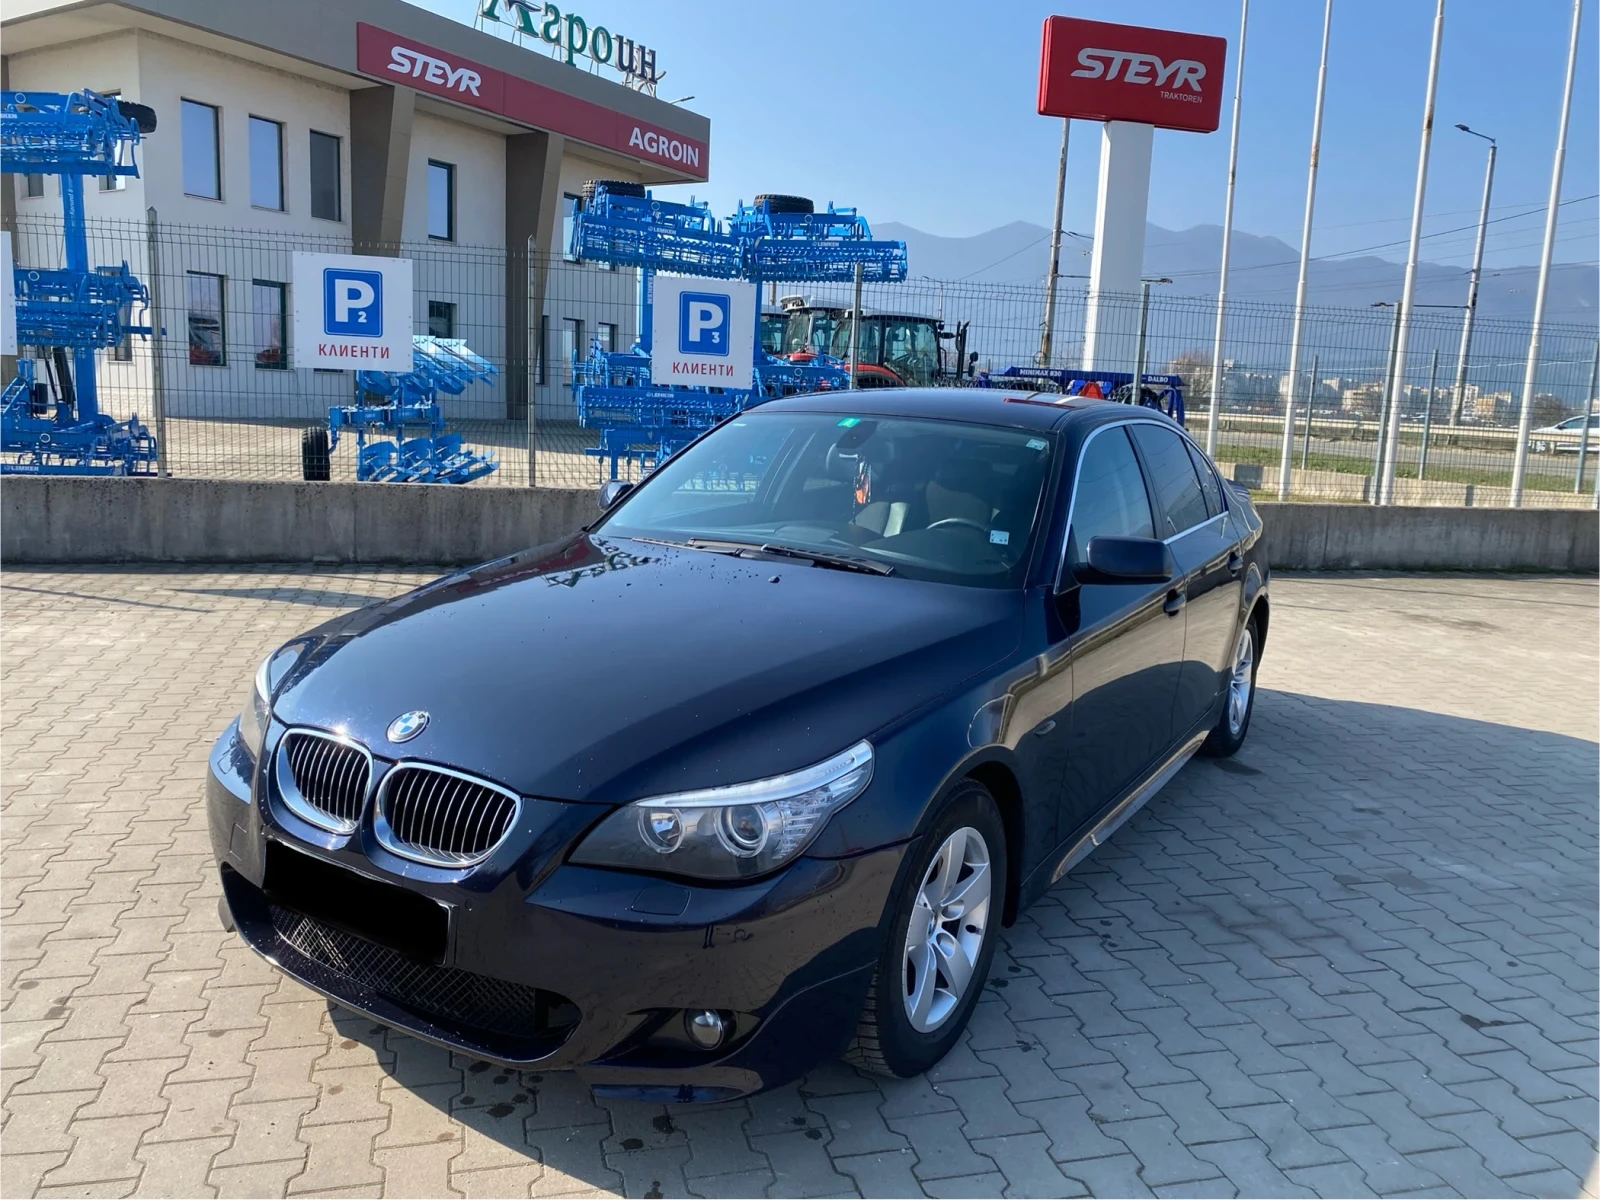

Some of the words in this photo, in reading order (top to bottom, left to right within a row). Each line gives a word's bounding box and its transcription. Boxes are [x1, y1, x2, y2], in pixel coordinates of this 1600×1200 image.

[387, 46, 481, 97] STEYR
[1070, 47, 1207, 92] STEYR
[1160, 91, 1203, 103] TRAKTOREN
[628, 126, 699, 168] AGROIN
[318, 343, 390, 359] КЛИЕНТИ
[672, 361, 734, 377] КЛИЕНТИ
[1147, 375, 1169, 383] DALBO
